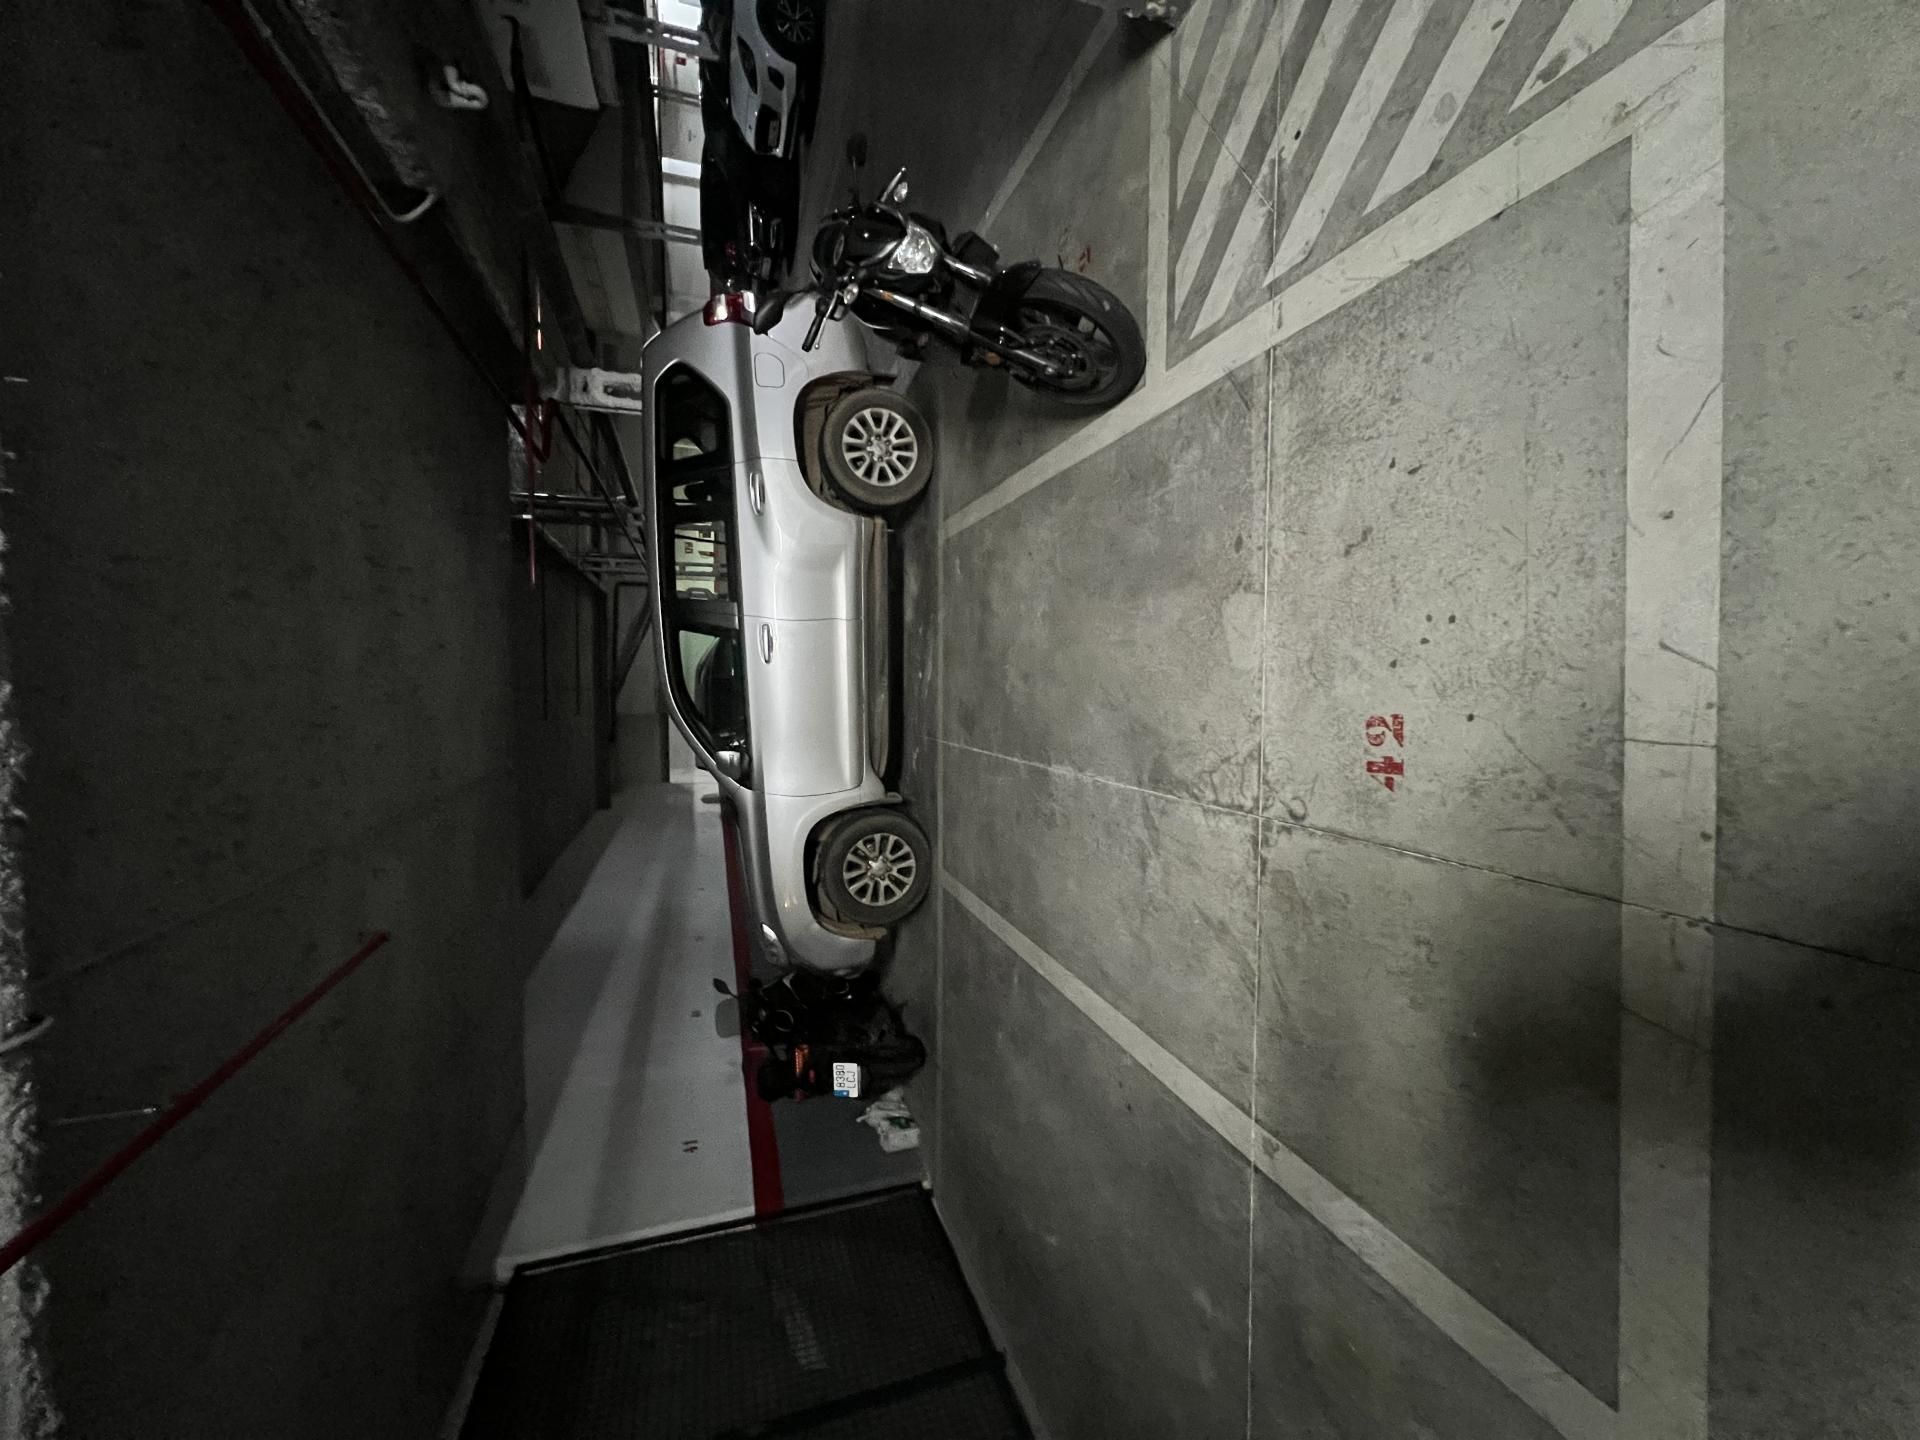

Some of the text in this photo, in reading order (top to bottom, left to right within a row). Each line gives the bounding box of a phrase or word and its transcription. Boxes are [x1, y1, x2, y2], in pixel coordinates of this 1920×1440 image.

[1365, 713, 1405, 793] 42
[835, 1064, 846, 1088] 8380
[846, 1070, 856, 1089] LCJ
